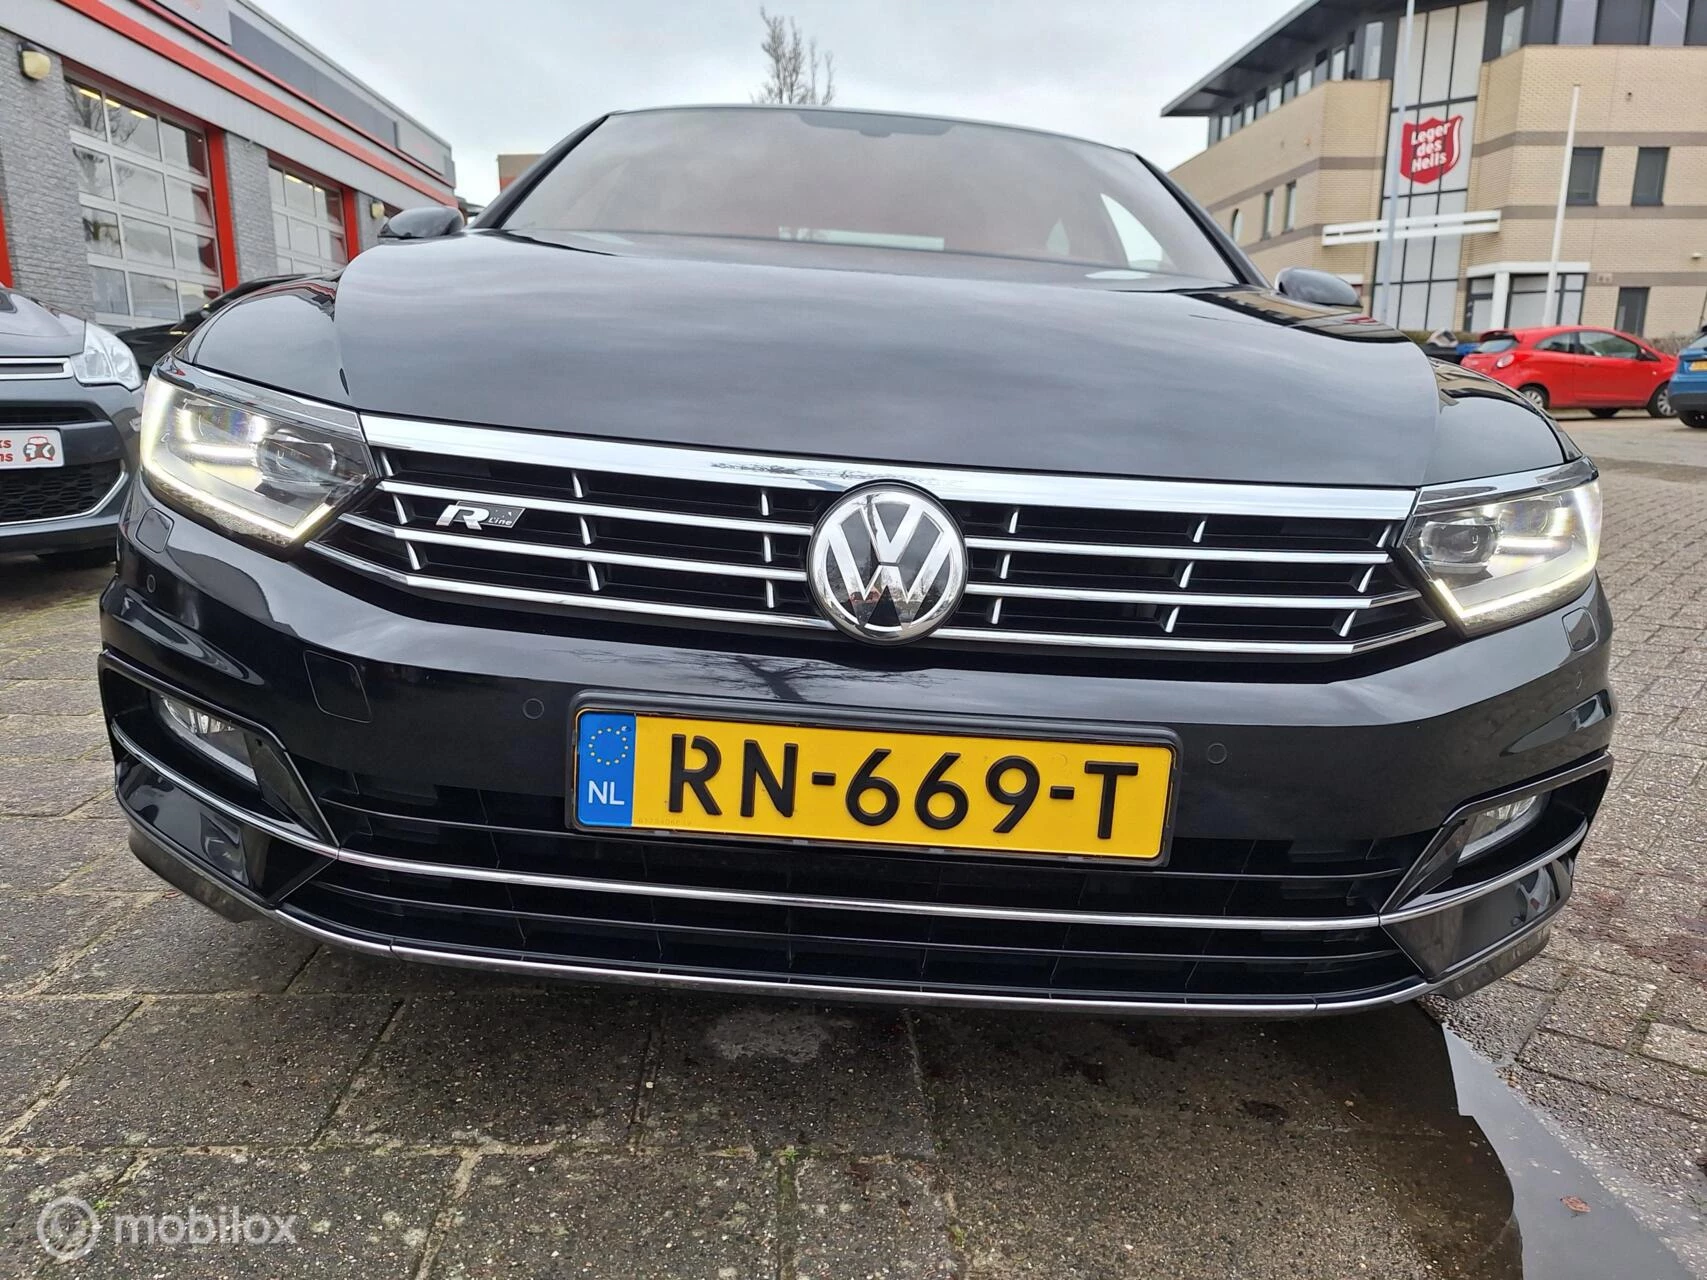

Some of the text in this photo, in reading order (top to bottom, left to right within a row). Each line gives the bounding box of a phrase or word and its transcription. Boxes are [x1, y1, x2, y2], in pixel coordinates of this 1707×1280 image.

[1411, 122, 1451, 145] Leger
[588, 780, 625, 806] NL
[668, 732, 1139, 840] RN-669-T
